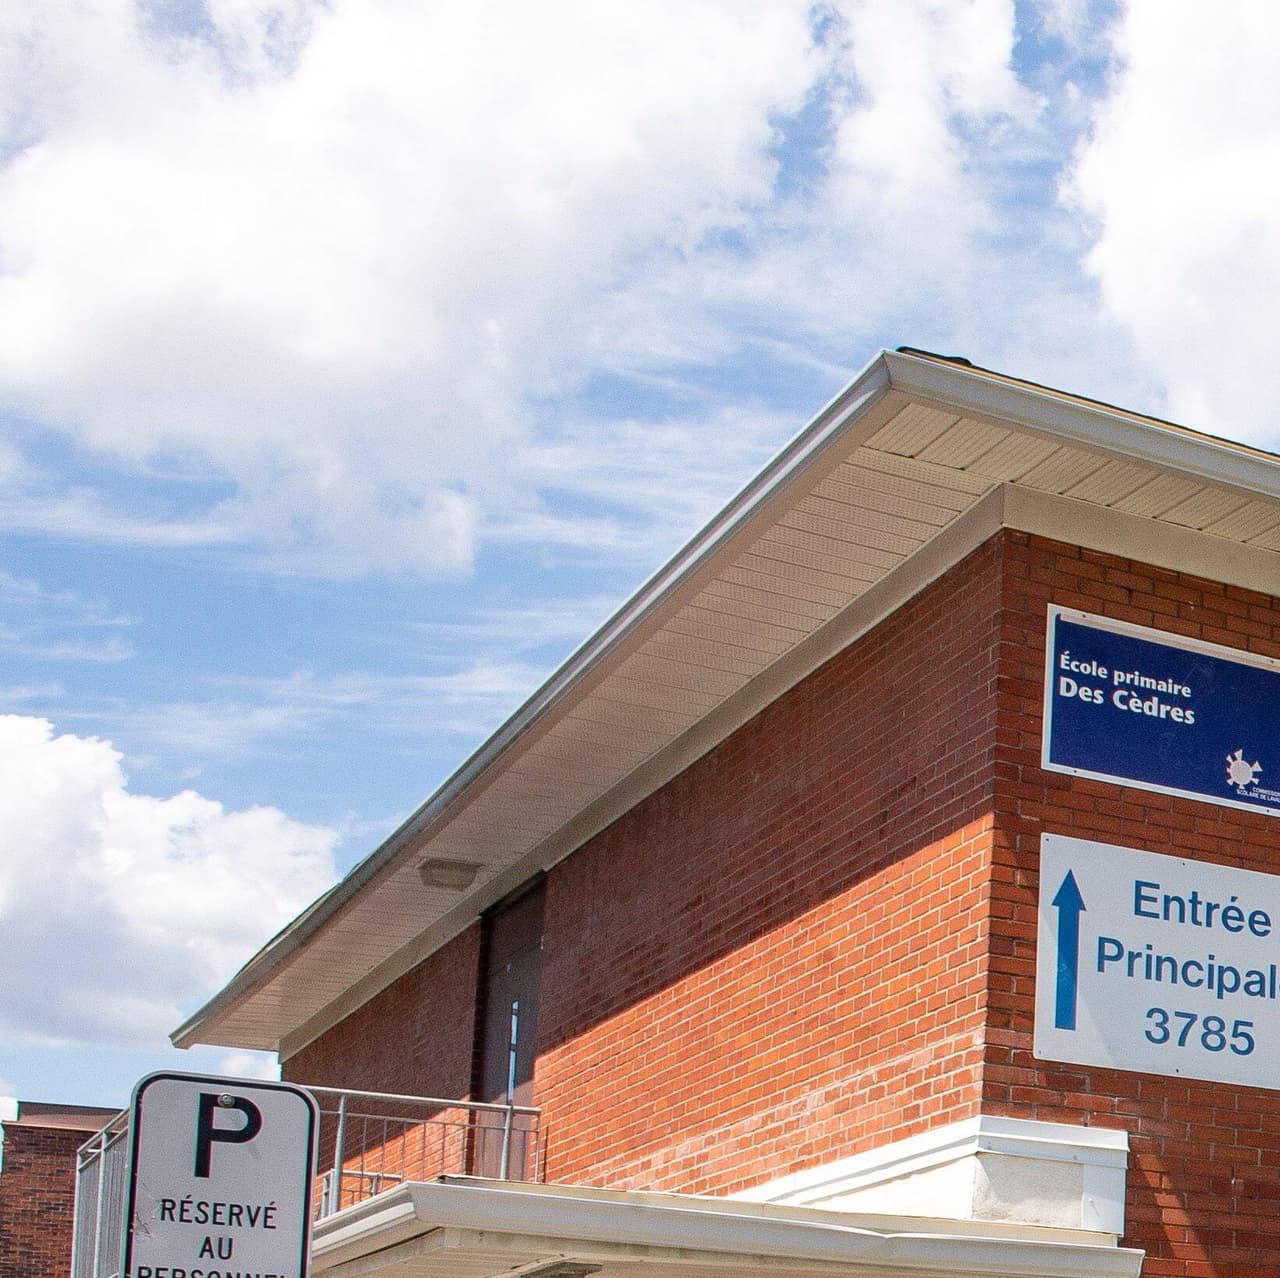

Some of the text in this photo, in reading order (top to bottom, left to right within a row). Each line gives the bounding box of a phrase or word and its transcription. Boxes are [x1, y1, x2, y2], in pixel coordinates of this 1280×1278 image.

[1060, 650, 1192, 698] École primaire
[1059, 676, 1196, 725] Des Cèdres
[1133, 879, 1272, 938] Entrée
[1144, 1006, 1255, 1056] 3785
[193, 1092, 263, 1179] P
[159, 1194, 278, 1230] RÉSERVÉ
[198, 1236, 234, 1260] AU
